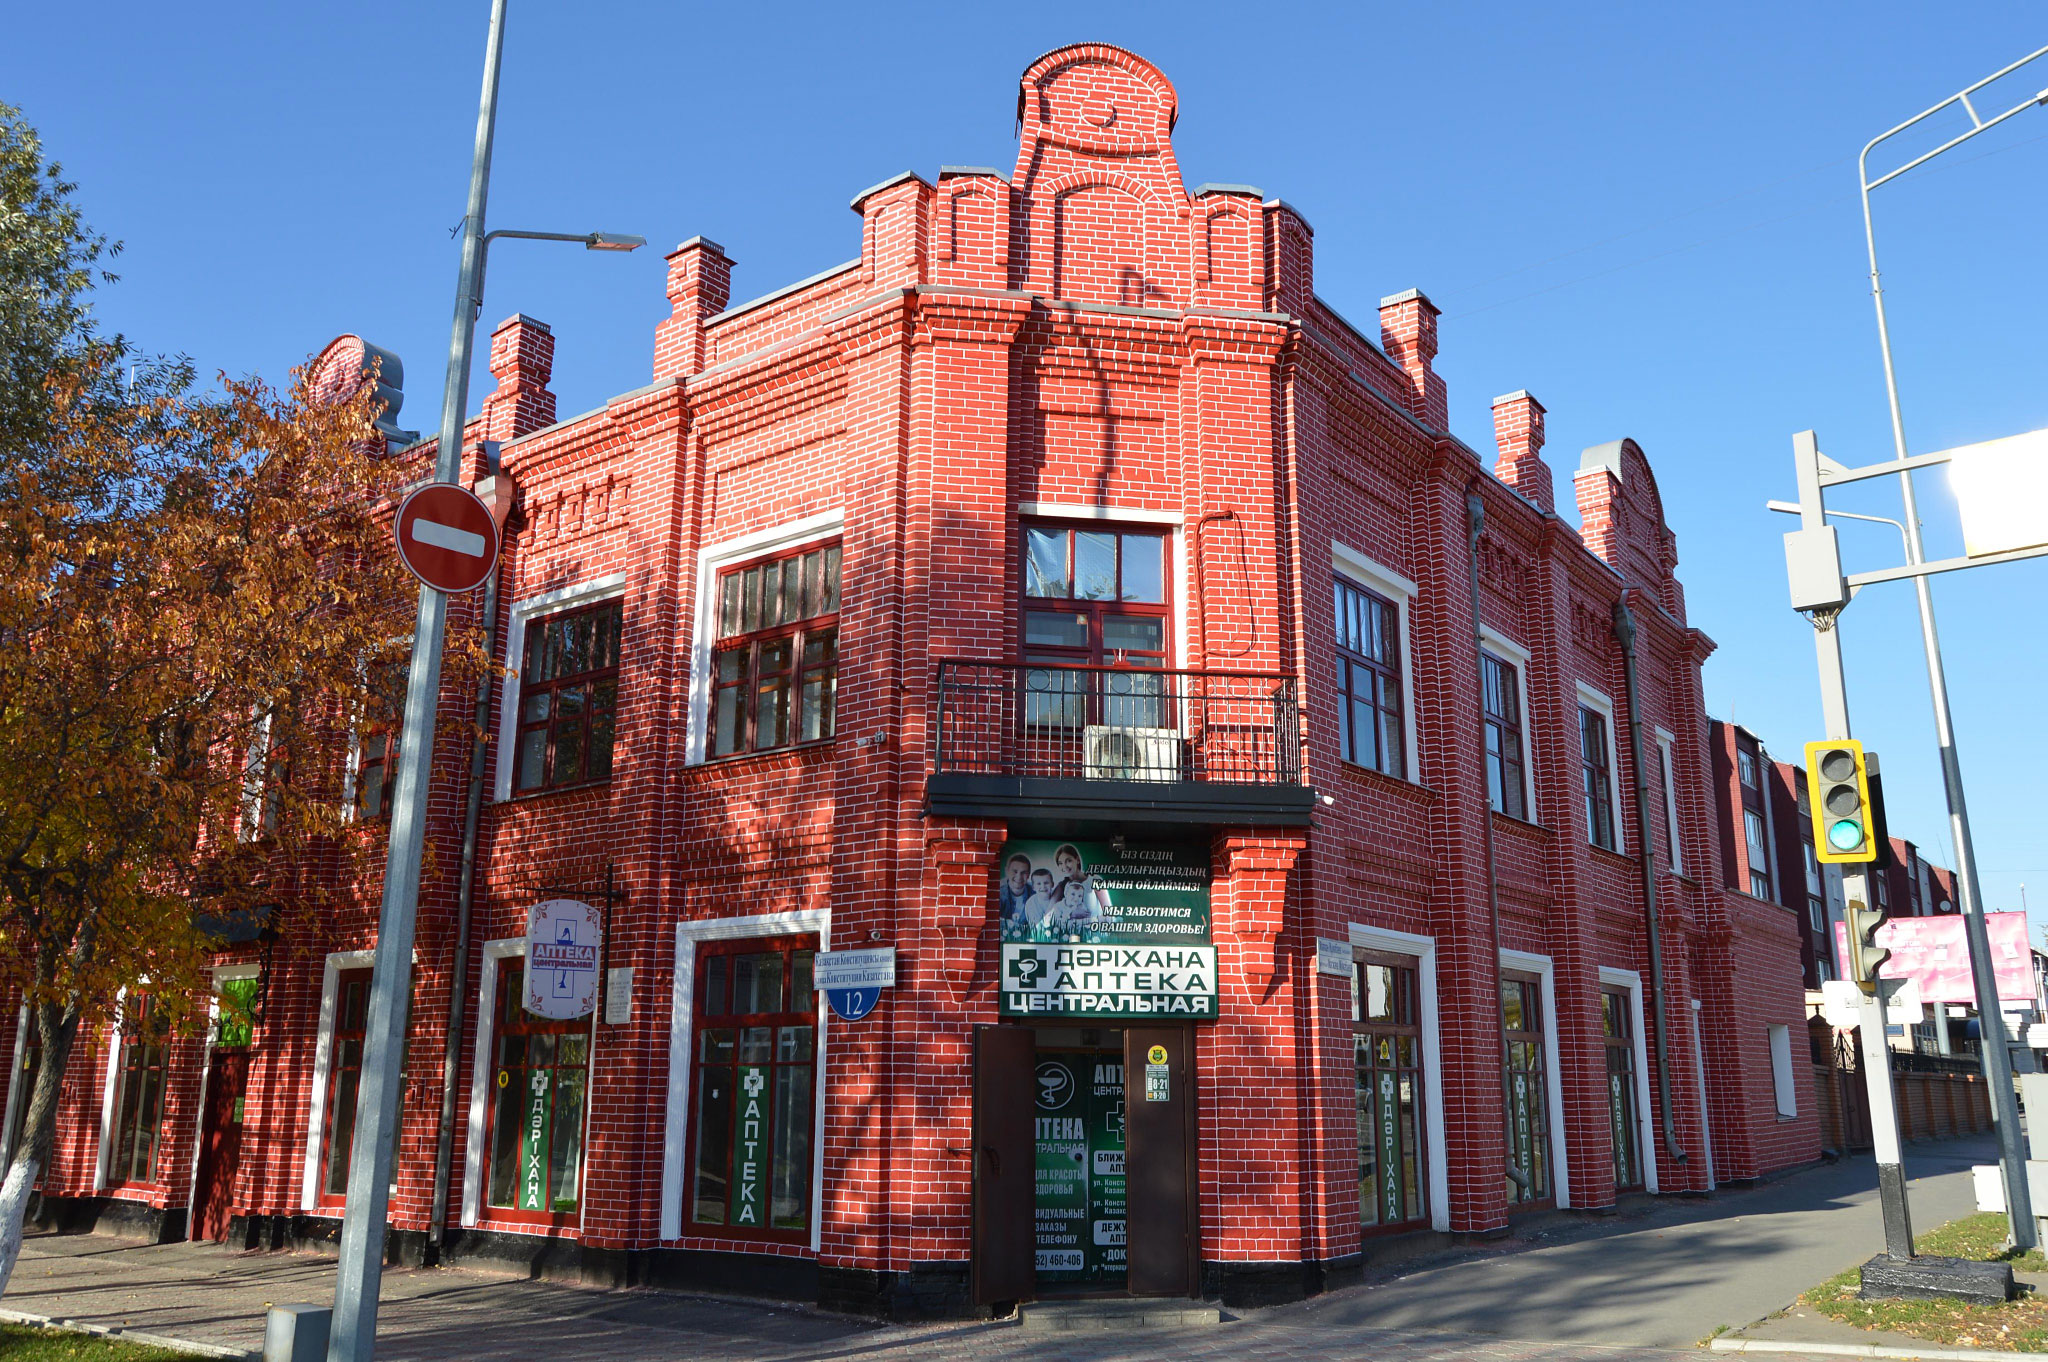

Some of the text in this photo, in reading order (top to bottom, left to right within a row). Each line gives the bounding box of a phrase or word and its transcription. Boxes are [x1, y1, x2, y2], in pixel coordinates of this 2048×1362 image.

[1120, 850, 1174, 862] БІЗ СІЗДІҢ
[1085, 864, 1207, 878] ДЕНСАУЛЫҒЫҢЫЗДЫҢ
[1092, 879, 1201, 892] ҚАМЫН ОЙЛАЙМЫЗ!
[1103, 906, 1192, 918] МЫ ЗАБОТИМСЯ
[1090, 923, 1205, 935] О ВАШЕМ ЗДОРОВЬЕ!
[534, 944, 595, 960] АПТЕКА
[533, 959, 593, 969] центральная
[1054, 949, 1206, 971] ДӘРІХАНА
[1053, 972, 1208, 992] АПТЕКА
[845, 991, 863, 1015] 12
[1009, 993, 1209, 1014] ЦЕНТРАЛЬНАЯ
[1152, 1078, 1168, 1090] 8-21
[1615, 1098, 1628, 1185] ДӘРІХАНА
[526, 1098, 544, 1208] ДӘРІХАНА
[1098, 1153, 1125, 1162] БЛИЖ
[738, 1100, 761, 1223] АПТЕКА
[1383, 1103, 1397, 1220] ДӘРІХАНА
[1049, 1169, 1084, 1180] КРАСОТЫ
[1036, 1184, 1074, 1195] ЗДОРОВЬЯ
[1036, 1222, 1067, 1232] ЗАКАЗЫ
[1036, 1234, 1078, 1245] ТЕЛЕФОНУ
[1050, 1254, 1081, 1266] 460-406
